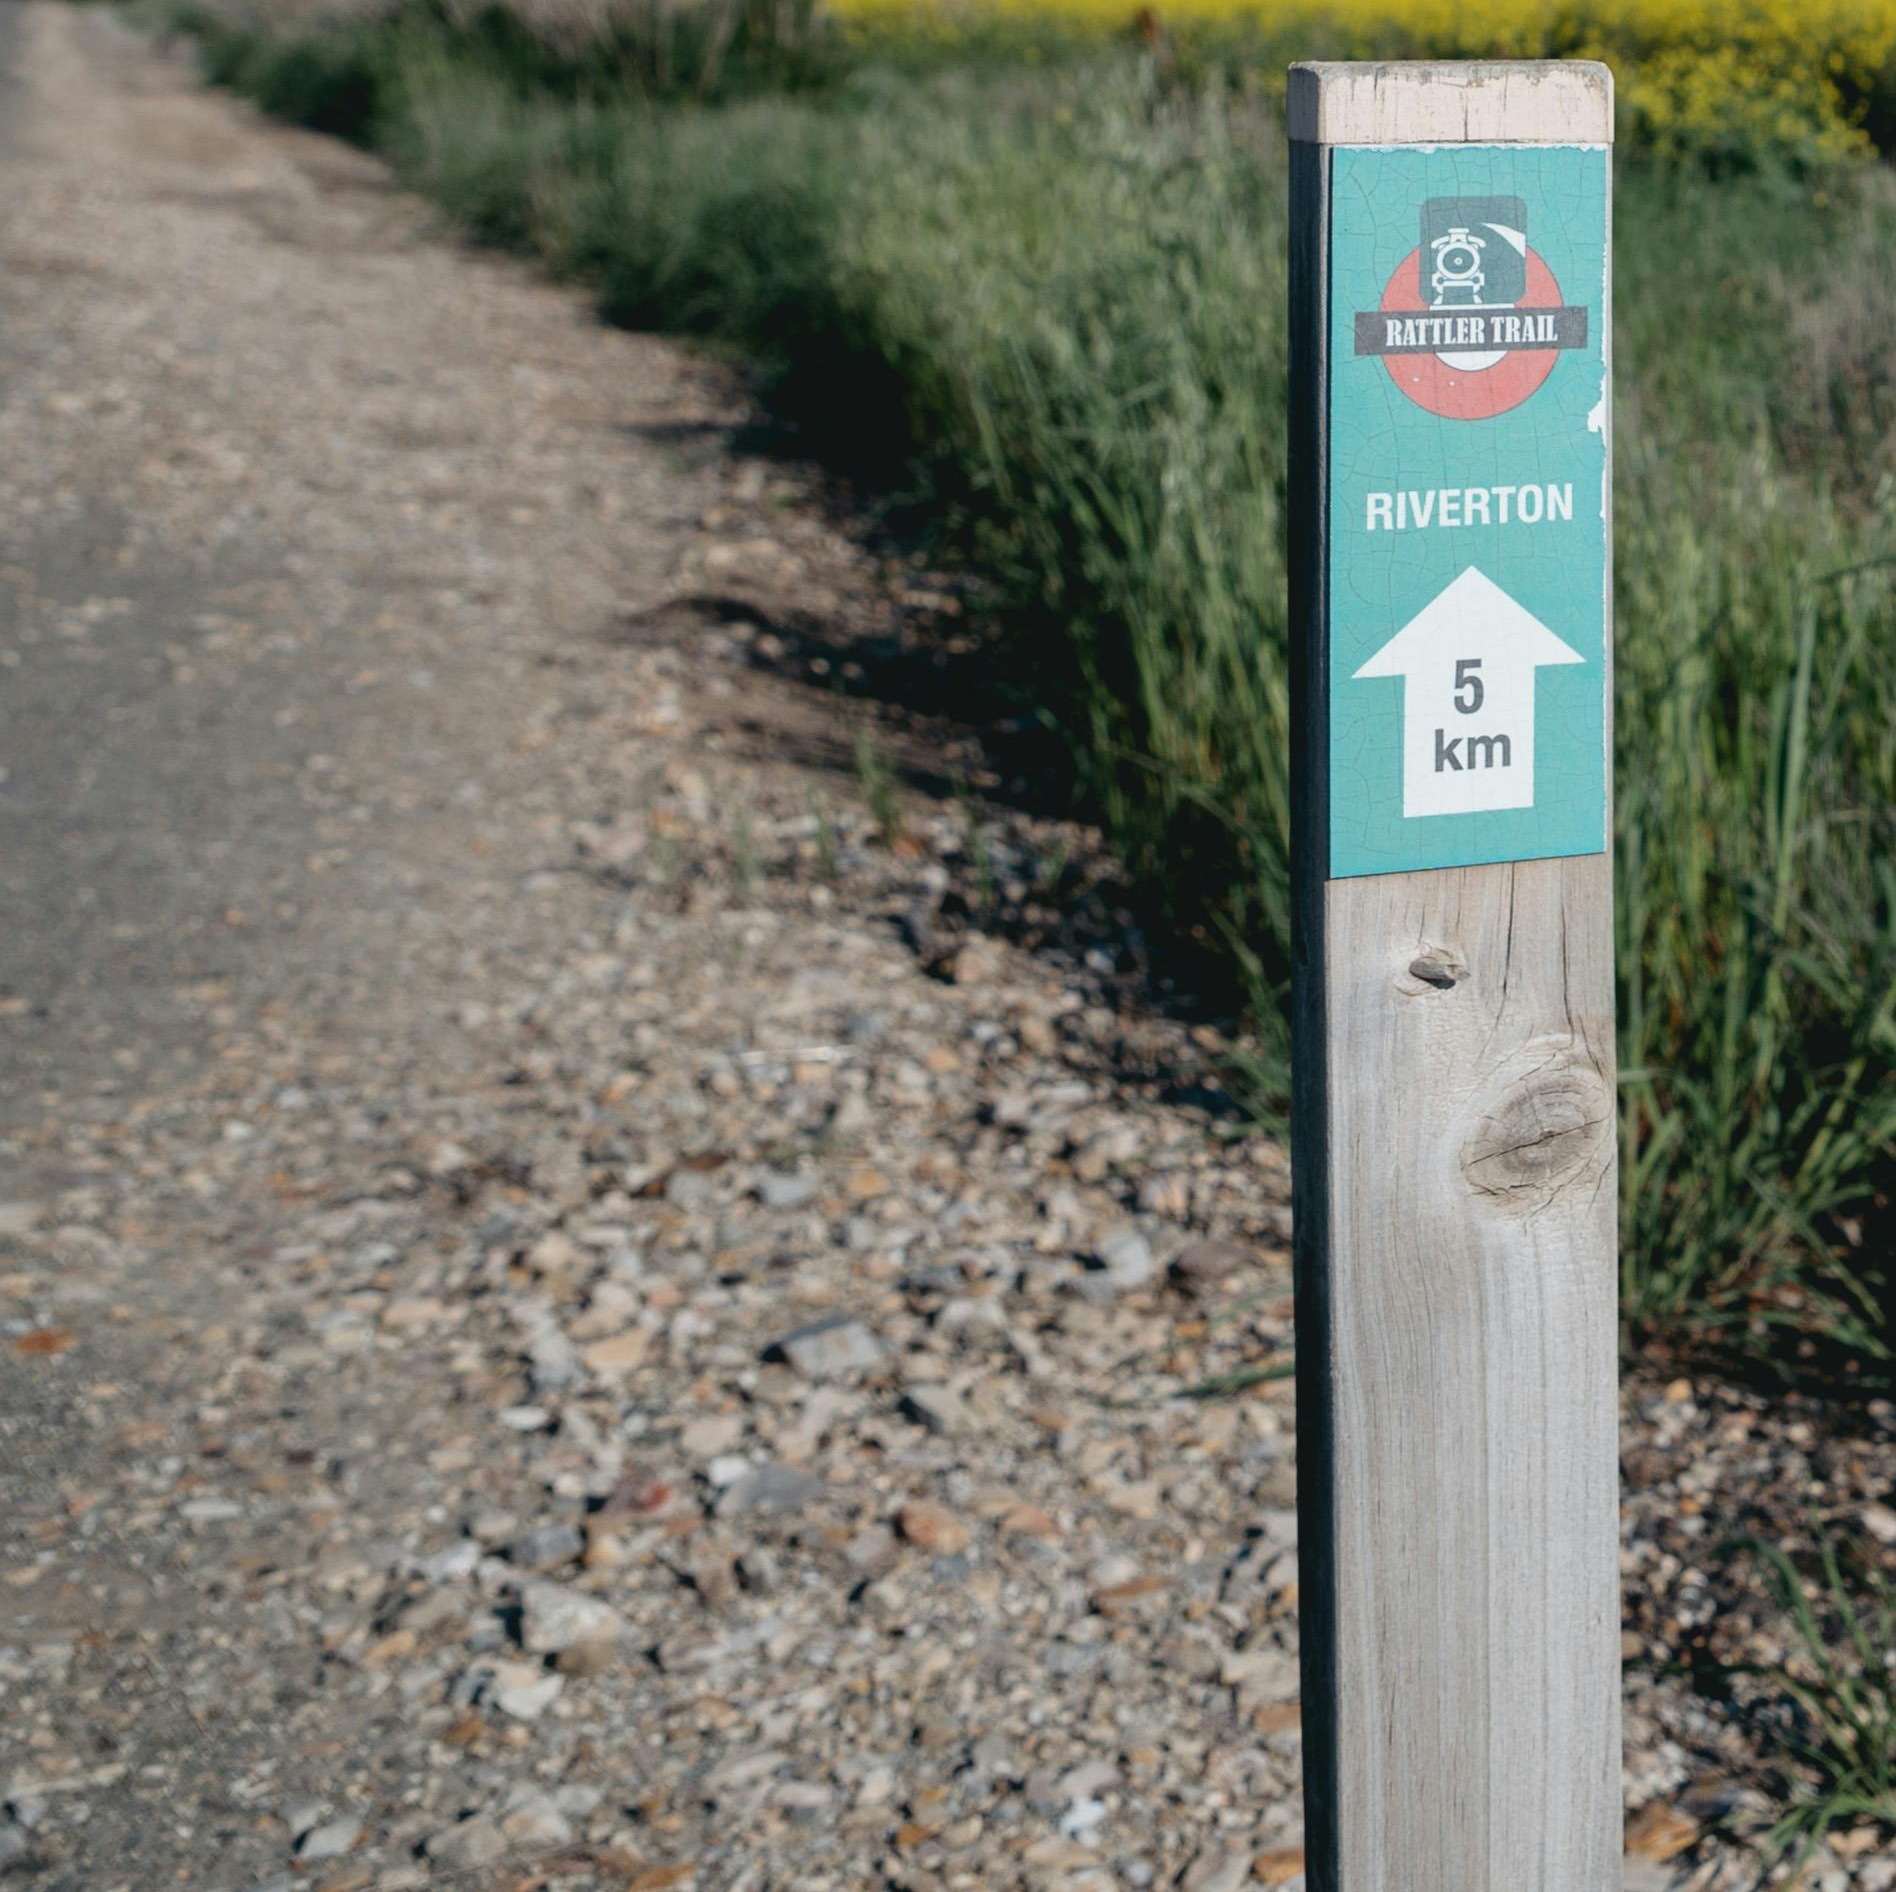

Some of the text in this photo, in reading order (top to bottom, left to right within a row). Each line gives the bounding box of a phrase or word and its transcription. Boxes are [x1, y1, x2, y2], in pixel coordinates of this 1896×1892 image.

[1386, 314, 1558, 346] RATTLER TRAIL
[1366, 483, 1573, 531] RIVERTON
[1453, 658, 1484, 714] 5
[1434, 728, 1511, 773] km
